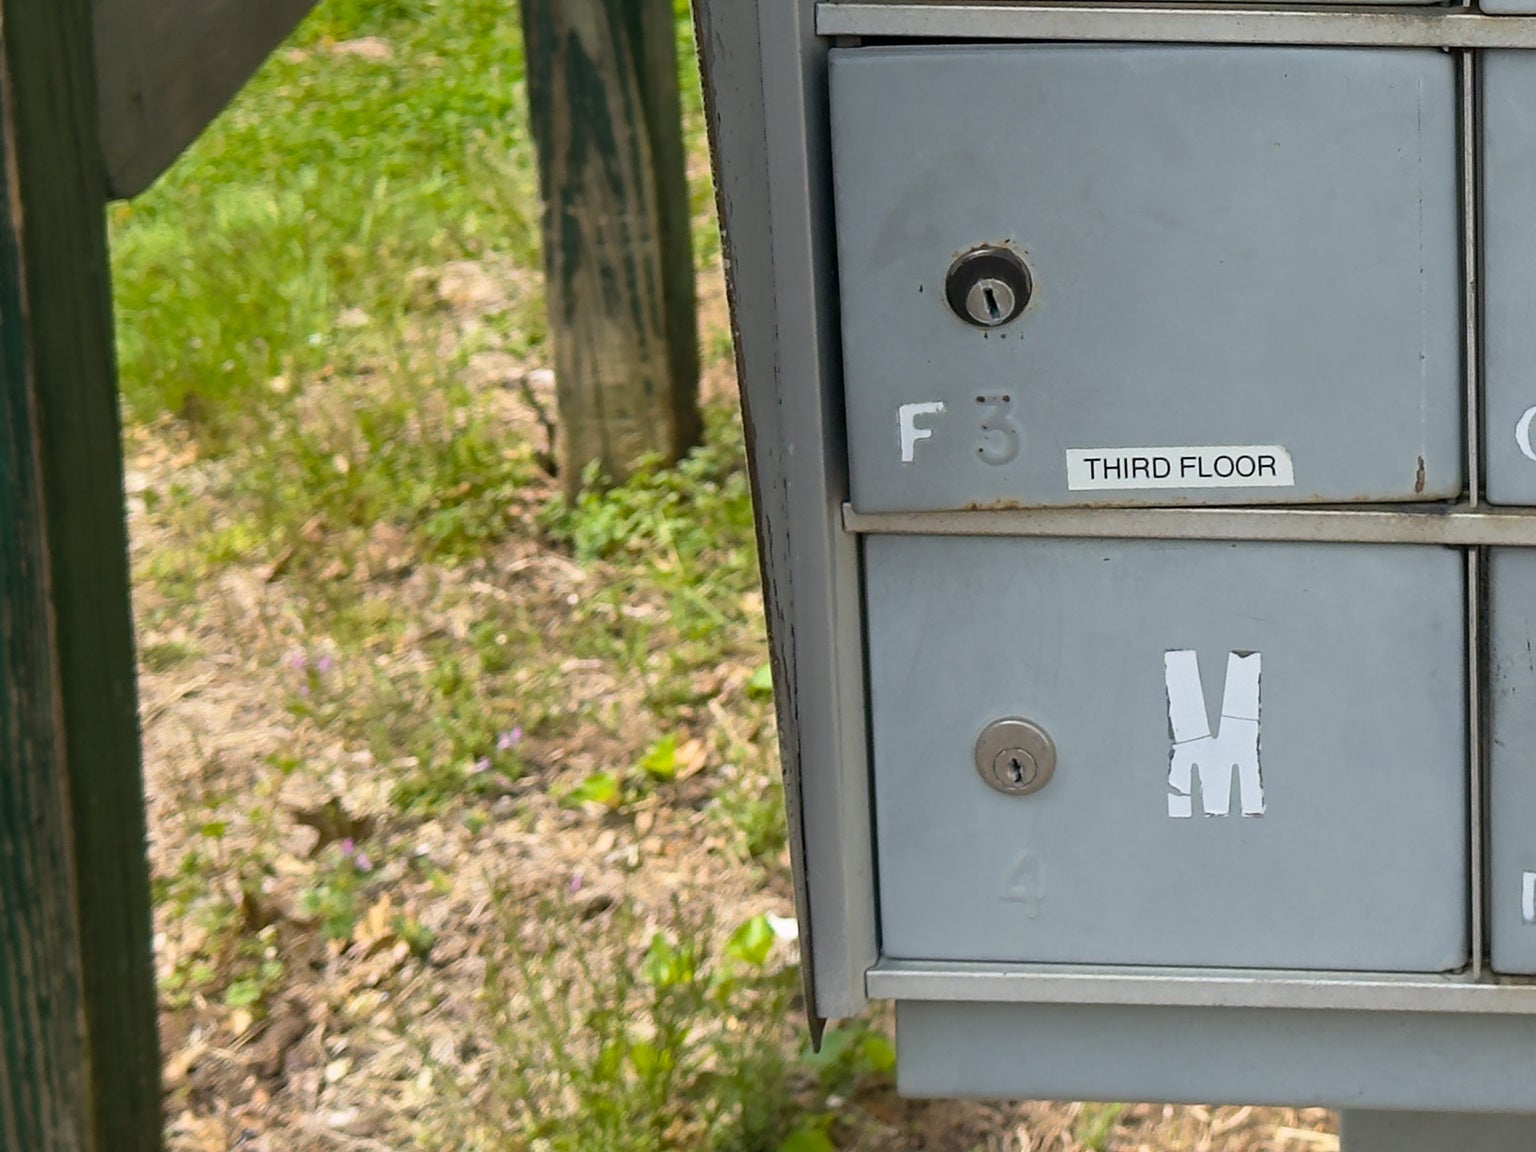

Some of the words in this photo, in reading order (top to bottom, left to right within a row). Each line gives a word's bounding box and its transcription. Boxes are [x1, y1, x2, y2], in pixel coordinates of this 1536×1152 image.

[899, 401, 945, 462] F
[975, 394, 1020, 466] 3
[1083, 456, 1171, 480] THIRD
[1179, 454, 1277, 479] FLOOR
[1163, 648, 1266, 819] M
